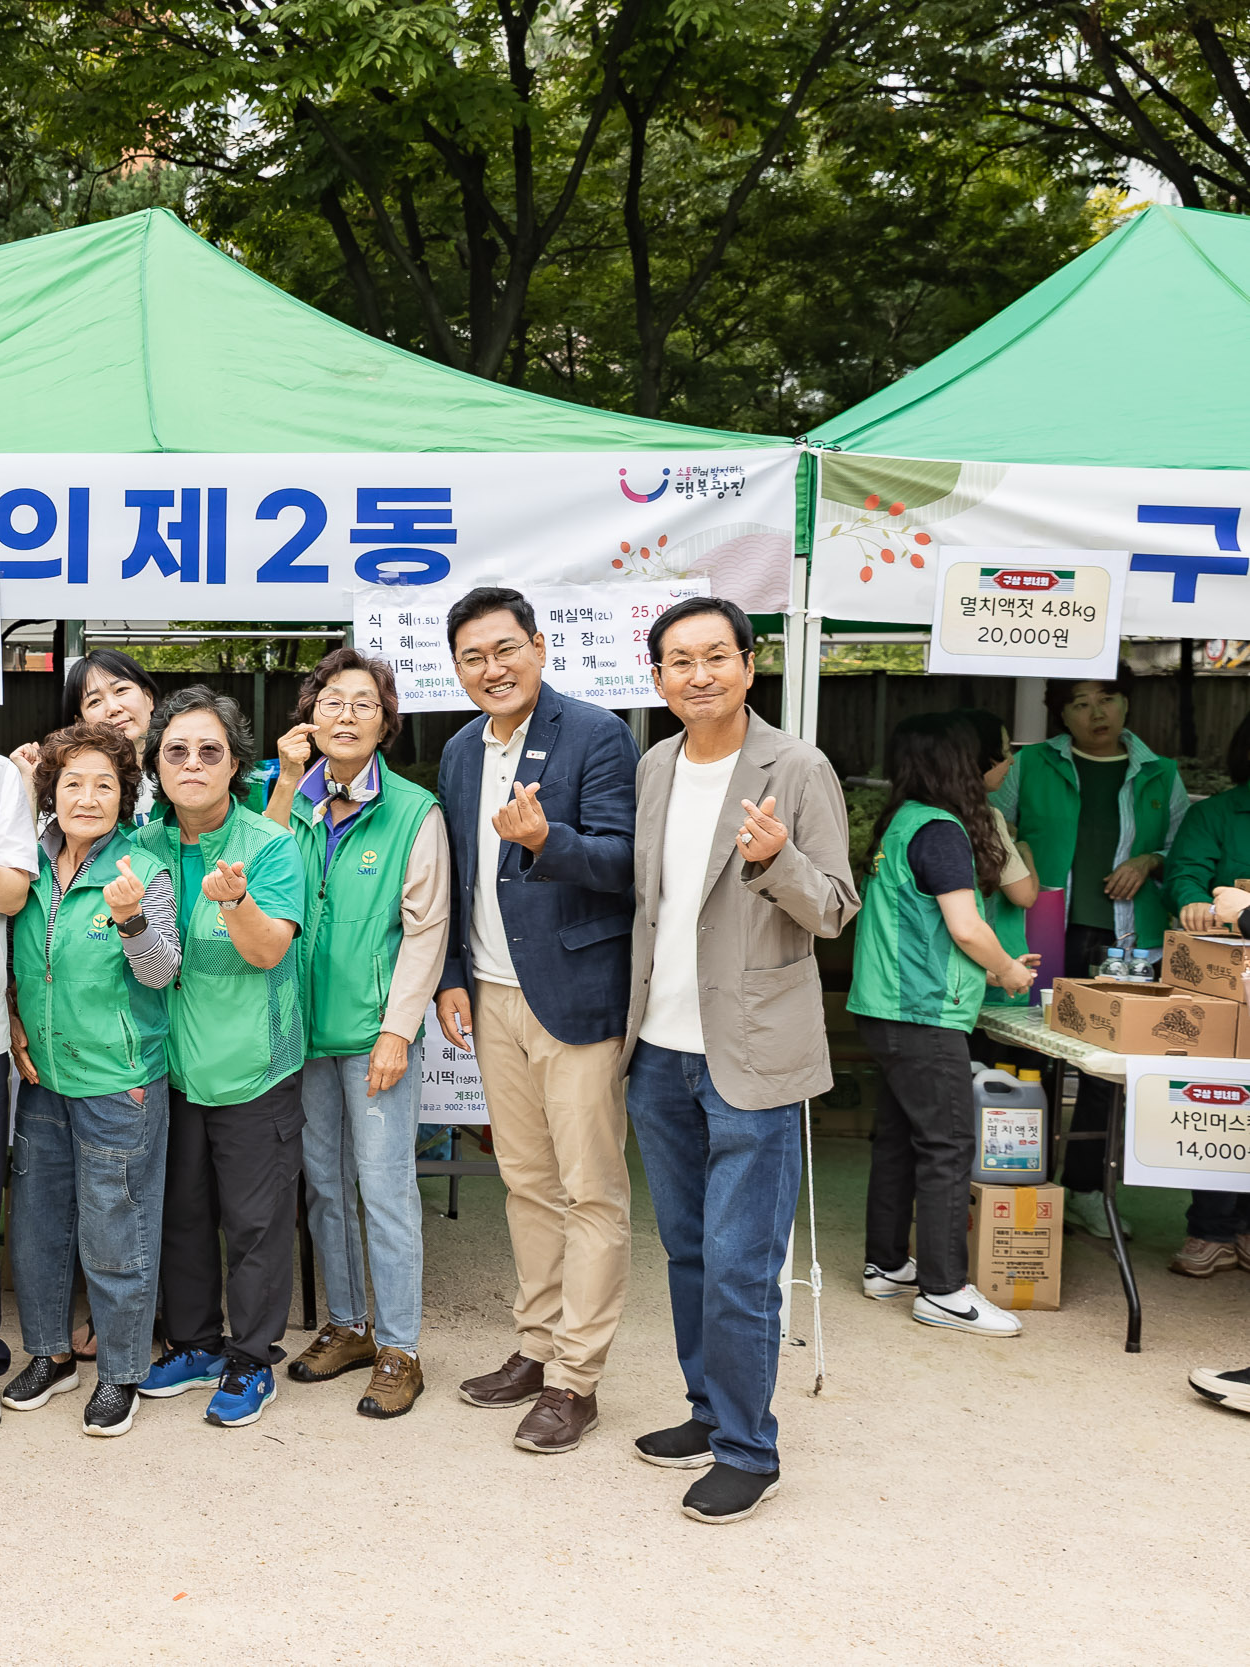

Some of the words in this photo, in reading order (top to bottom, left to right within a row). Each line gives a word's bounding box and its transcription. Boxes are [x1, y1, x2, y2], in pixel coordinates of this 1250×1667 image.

[675, 477, 746, 499] 행복광진
[550, 607, 613, 623] 매실액(2L)
[960, 596, 1034, 618] 멸치액젓
[1041, 600, 1096, 622] 4.8kg
[977, 627, 1069, 648] 20,000원
[414, 677, 455, 688] 계좌이체
[594, 676, 634, 686] 계좌이체
[356, 867, 378, 876] SMU
[86, 931, 109, 941] SMU
[454, 1091, 484, 1101] 계좌이
[1170, 1111, 1250, 1132] 샤인머스
[1176, 1140, 1250, 1161] 14,000
